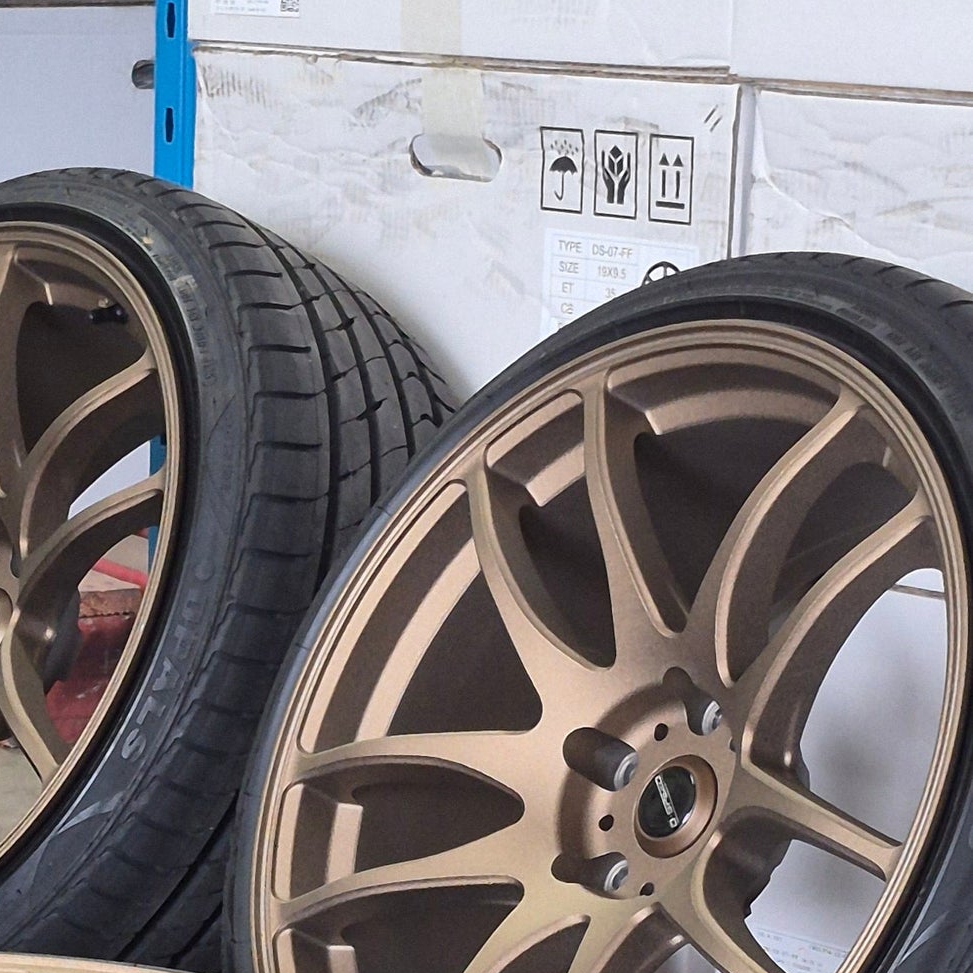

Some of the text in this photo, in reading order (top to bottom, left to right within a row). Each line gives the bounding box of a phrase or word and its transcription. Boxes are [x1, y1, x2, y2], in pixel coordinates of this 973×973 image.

[558, 240, 633, 258] TYPE DS-07-FF
[558, 261, 579, 274] SIZE
[561, 281, 574, 294] ET
